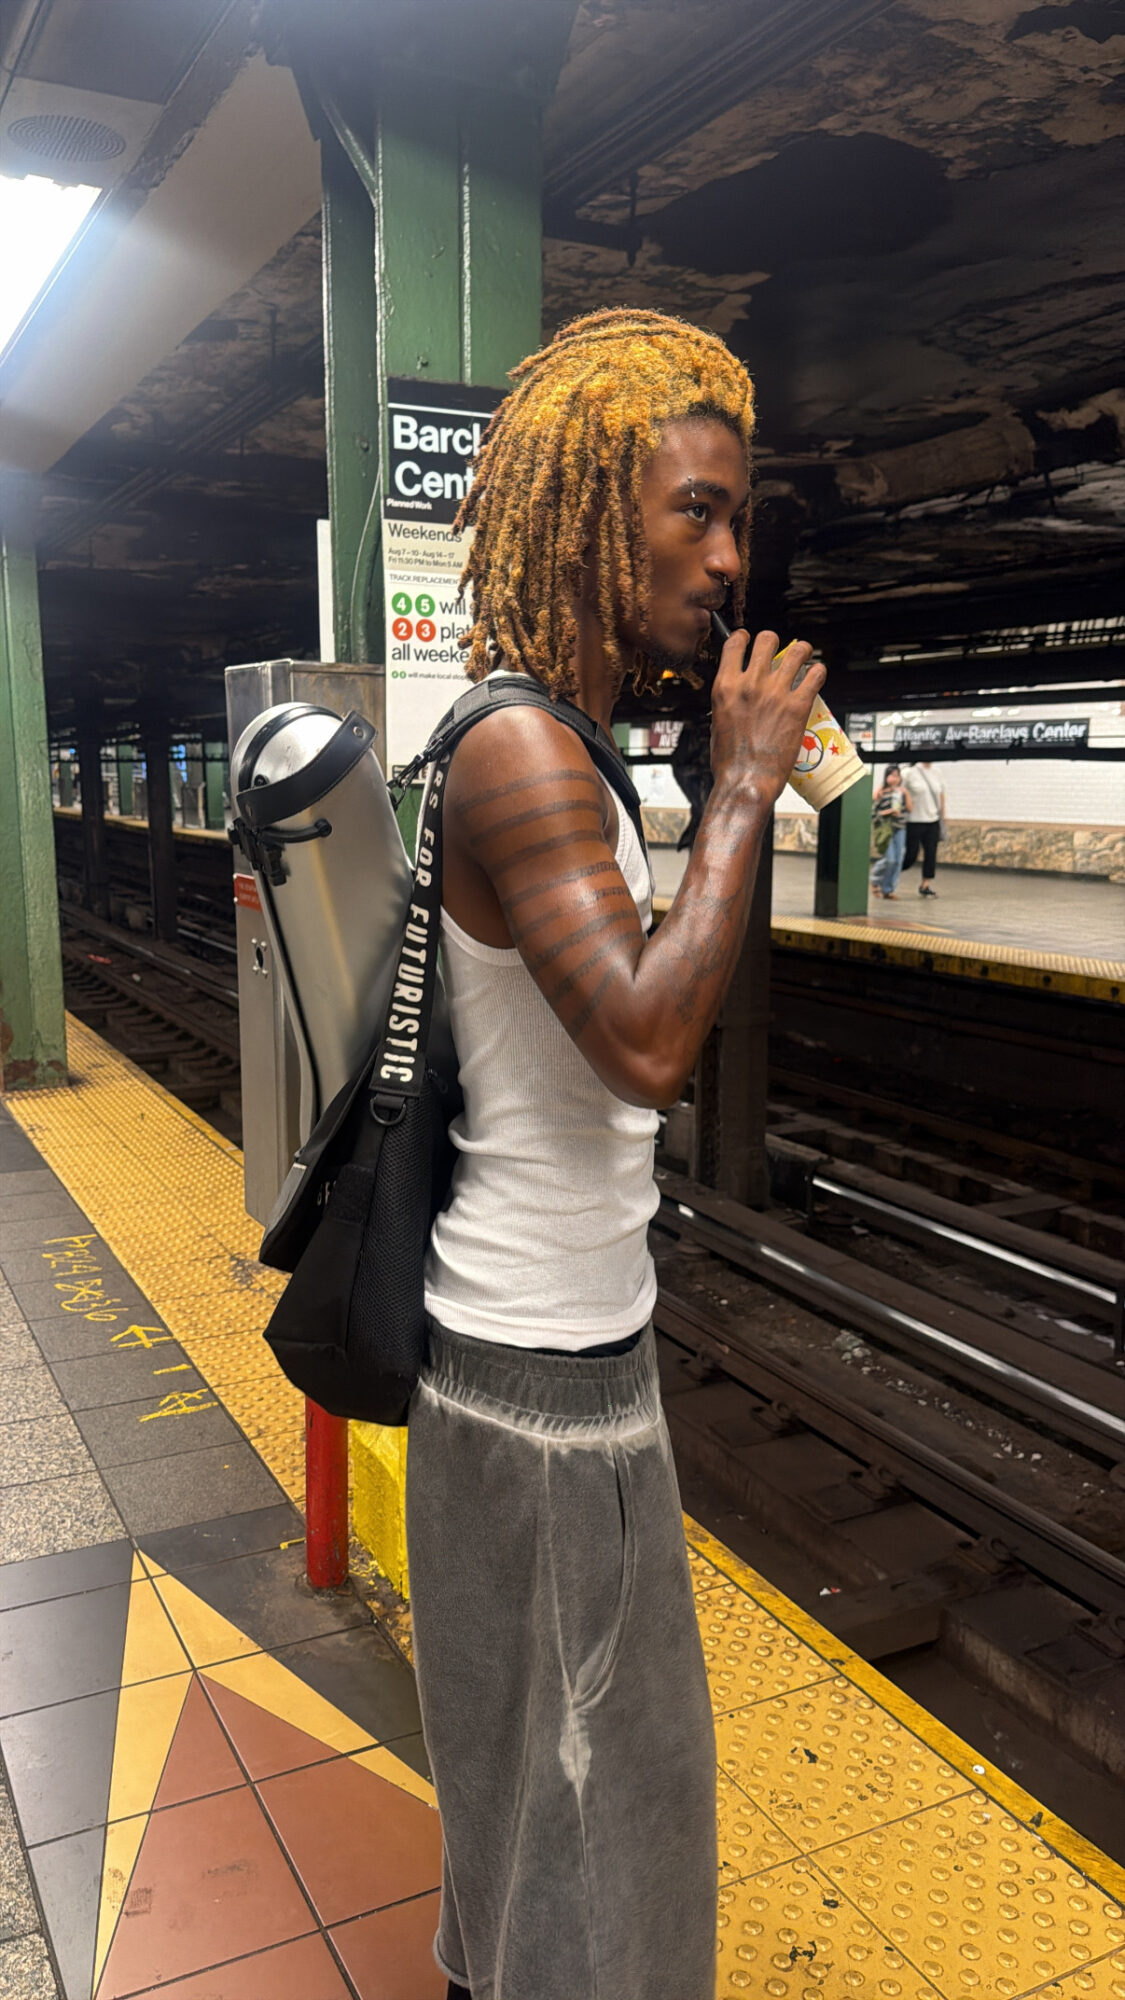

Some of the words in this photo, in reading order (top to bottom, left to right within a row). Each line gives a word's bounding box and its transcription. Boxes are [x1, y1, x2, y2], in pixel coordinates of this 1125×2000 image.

[393, 414, 480, 456] Barcl
[394, 460, 475, 499] Cent
[440, 598, 467, 616] will
[392, 643, 411, 661] all
[414, 645, 470, 664] weeke
[894, 727, 942, 745] Atlantic
[1032, 720, 1087, 742] Center
[415, 827, 435, 888] FOR
[380, 903, 430, 1082] FUTURISTIC
